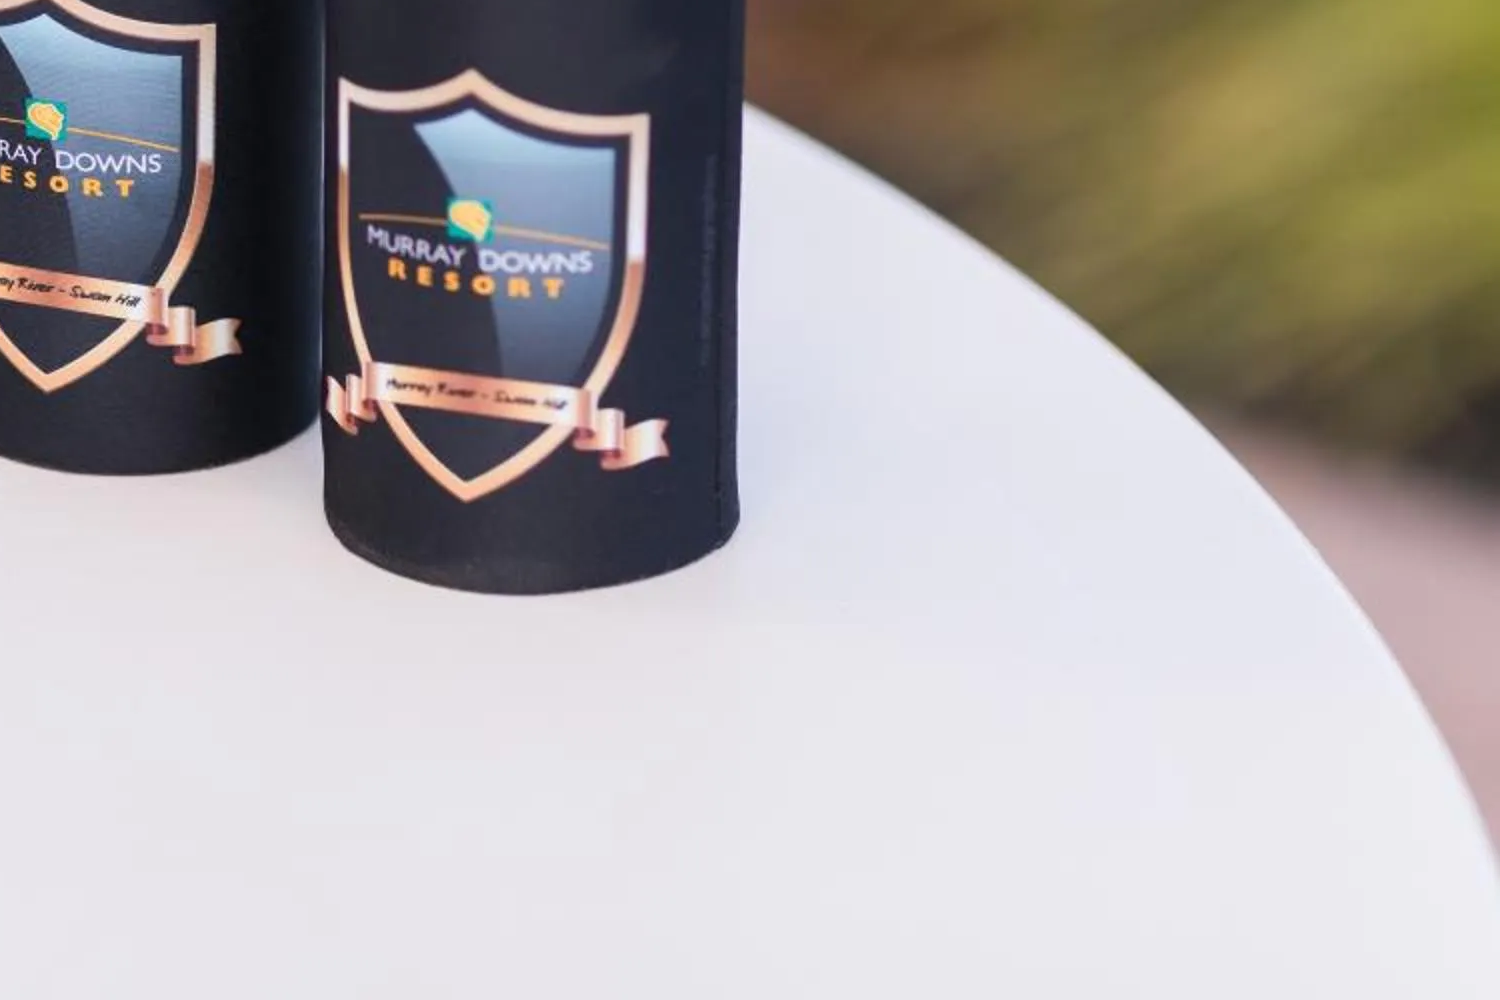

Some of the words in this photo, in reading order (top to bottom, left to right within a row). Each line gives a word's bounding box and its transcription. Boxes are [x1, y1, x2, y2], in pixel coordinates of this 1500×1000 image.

[54, 150, 162, 174] DOWNS
[367, 224, 466, 267] MURRAY
[477, 250, 594, 273] DOWNS
[17, 276, 56, 293] River
[69, 284, 112, 303] Swan
[115, 292, 141, 308] Hill
[388, 256, 564, 298] RESORT
